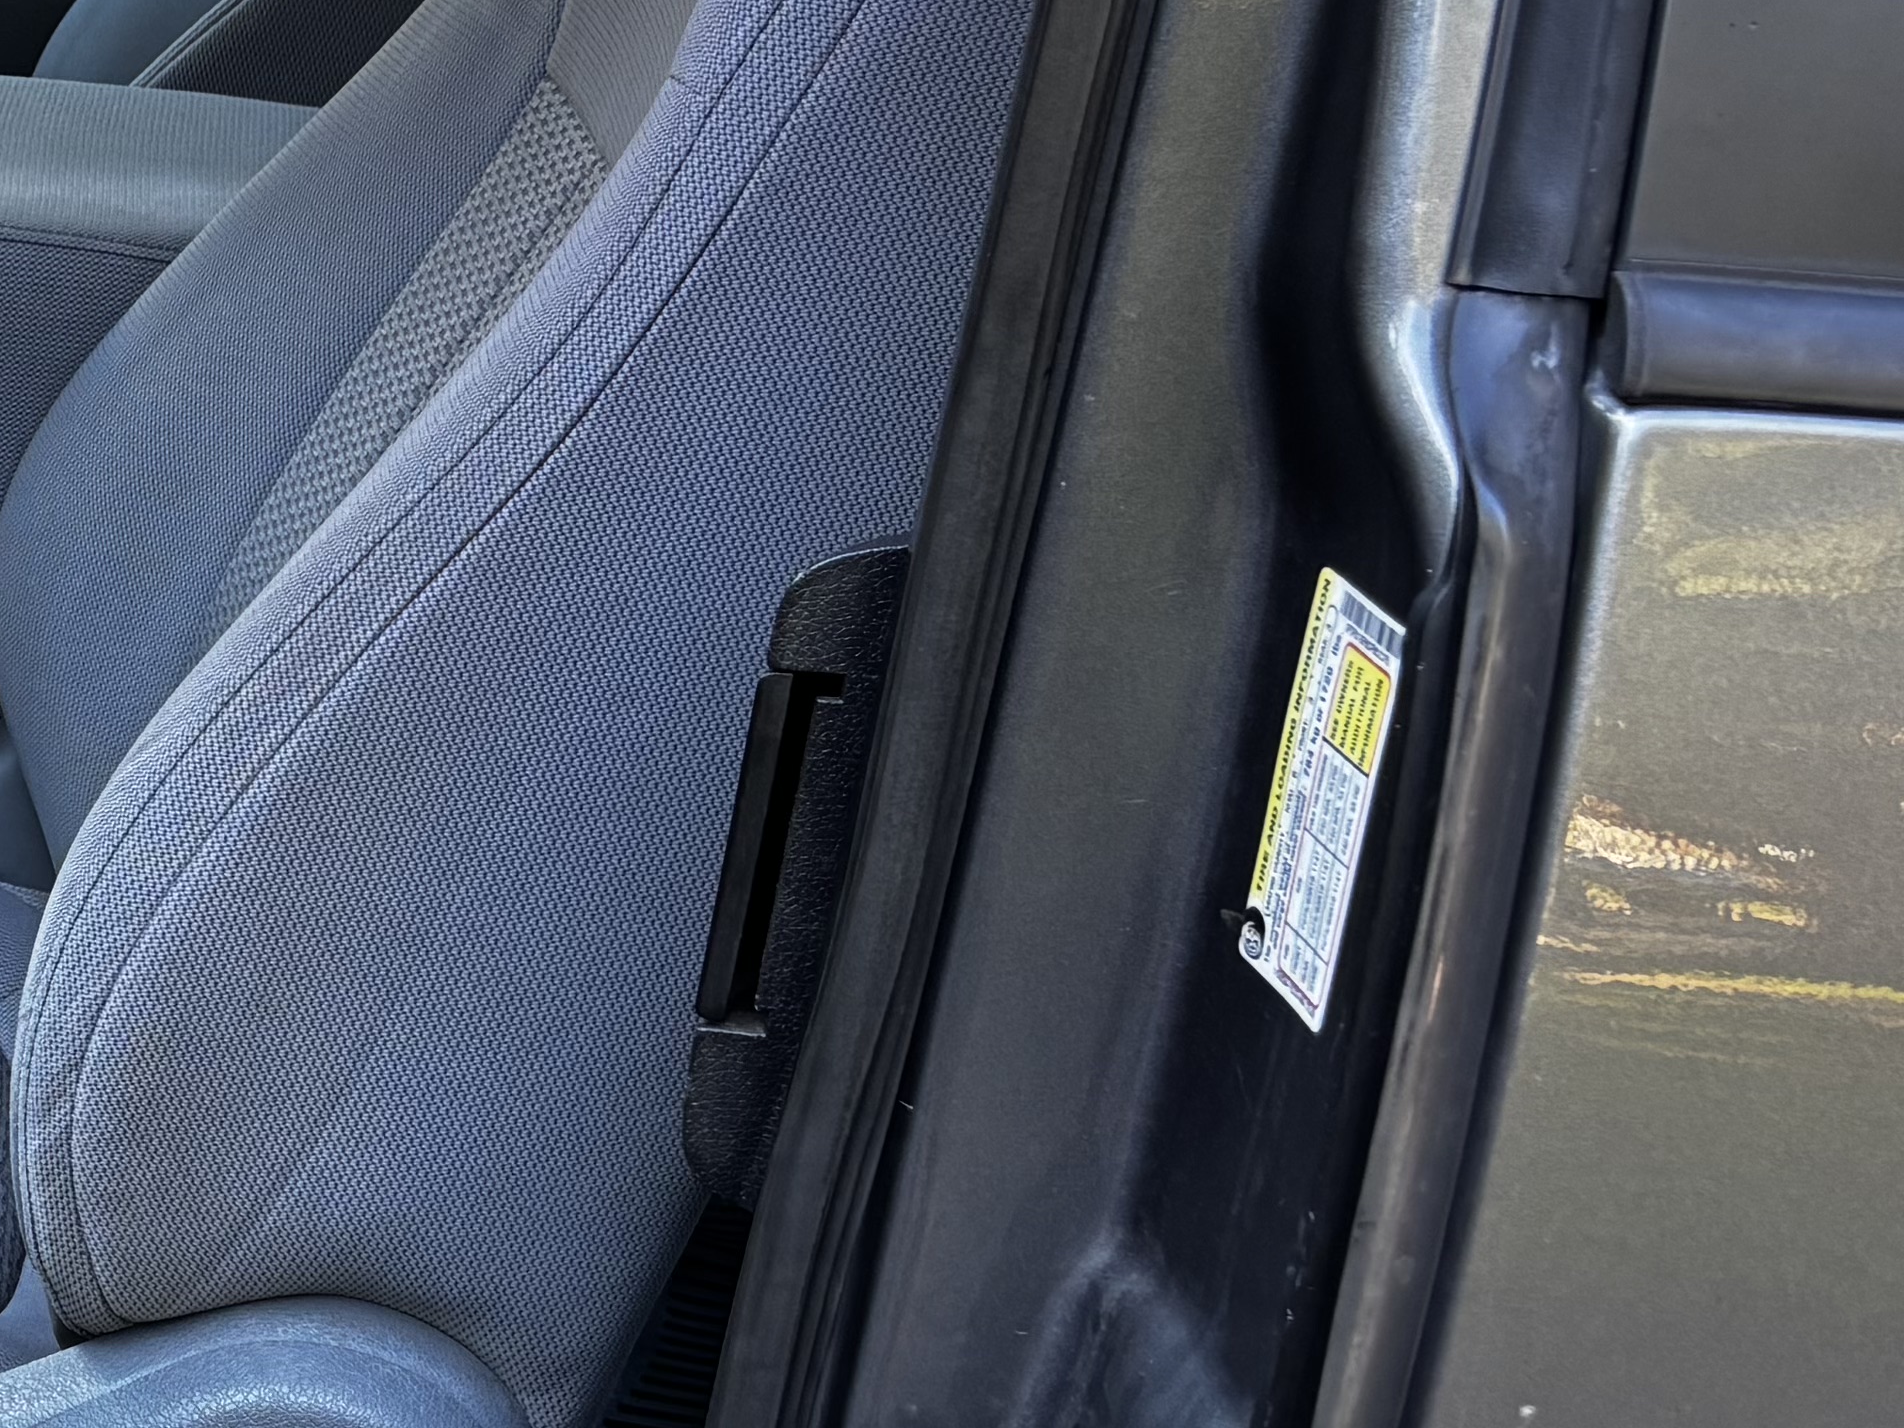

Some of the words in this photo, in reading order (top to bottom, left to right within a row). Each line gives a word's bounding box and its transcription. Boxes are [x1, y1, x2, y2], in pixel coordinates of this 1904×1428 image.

[1255, 850, 1270, 892] TIRE
[1267, 806, 1279, 843] AND
[1275, 717, 1297, 802] LOADING
[1293, 577, 1332, 712] INFORMATION
